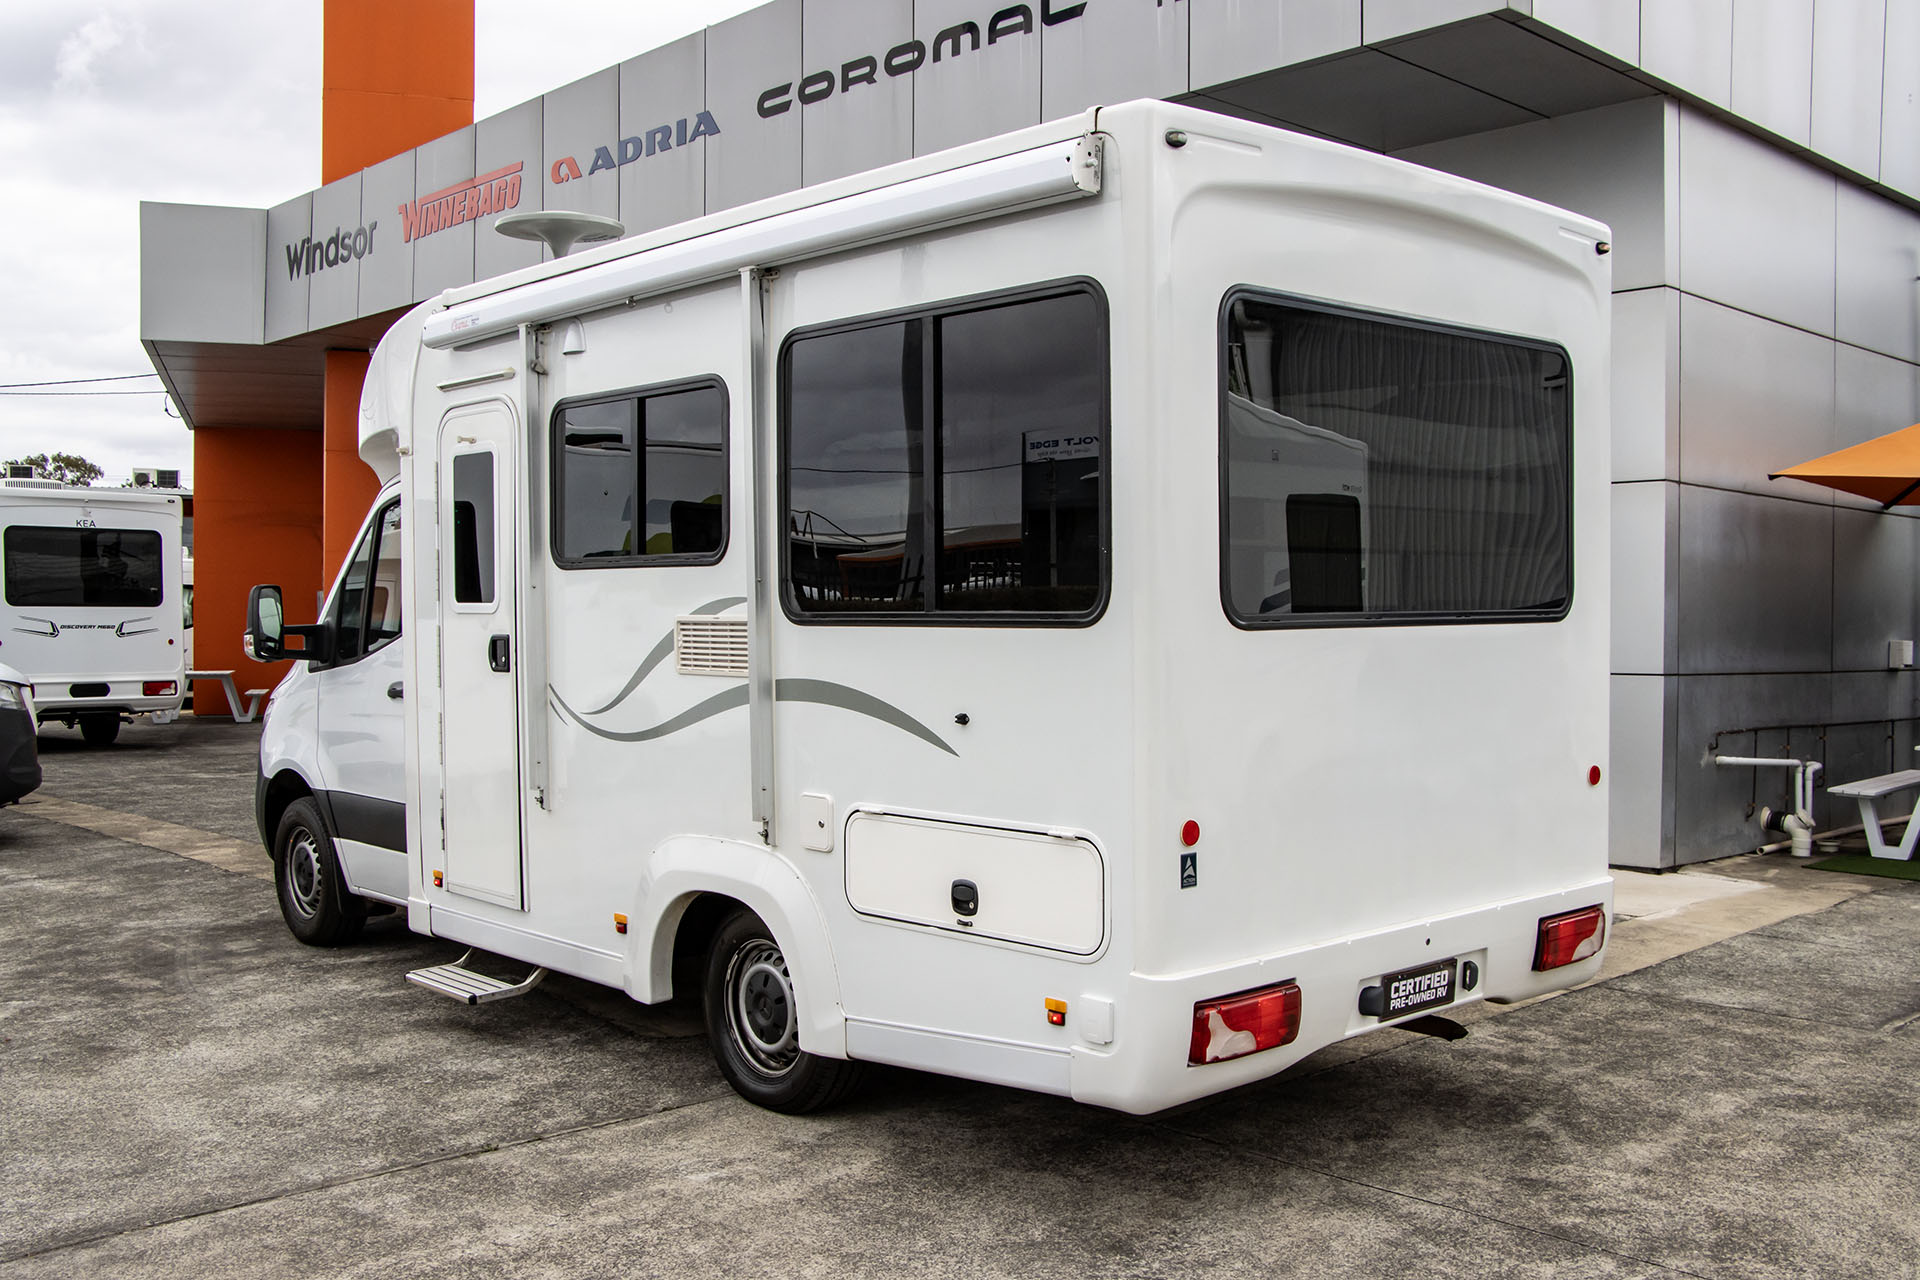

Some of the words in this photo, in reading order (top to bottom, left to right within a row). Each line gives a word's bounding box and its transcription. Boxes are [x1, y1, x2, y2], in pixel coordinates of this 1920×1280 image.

[757, 0, 1088, 119] COROMAL
[588, 110, 721, 176] ADRIA
[397, 166, 523, 243] WINNEBAGO
[286, 221, 377, 281] Windsor
[75, 519, 96, 528] KEA
[1389, 988, 1436, 1011] PRE-OWNED
[1436, 985, 1448, 998] RV
[1390, 969, 1449, 999] CERTIFIED
